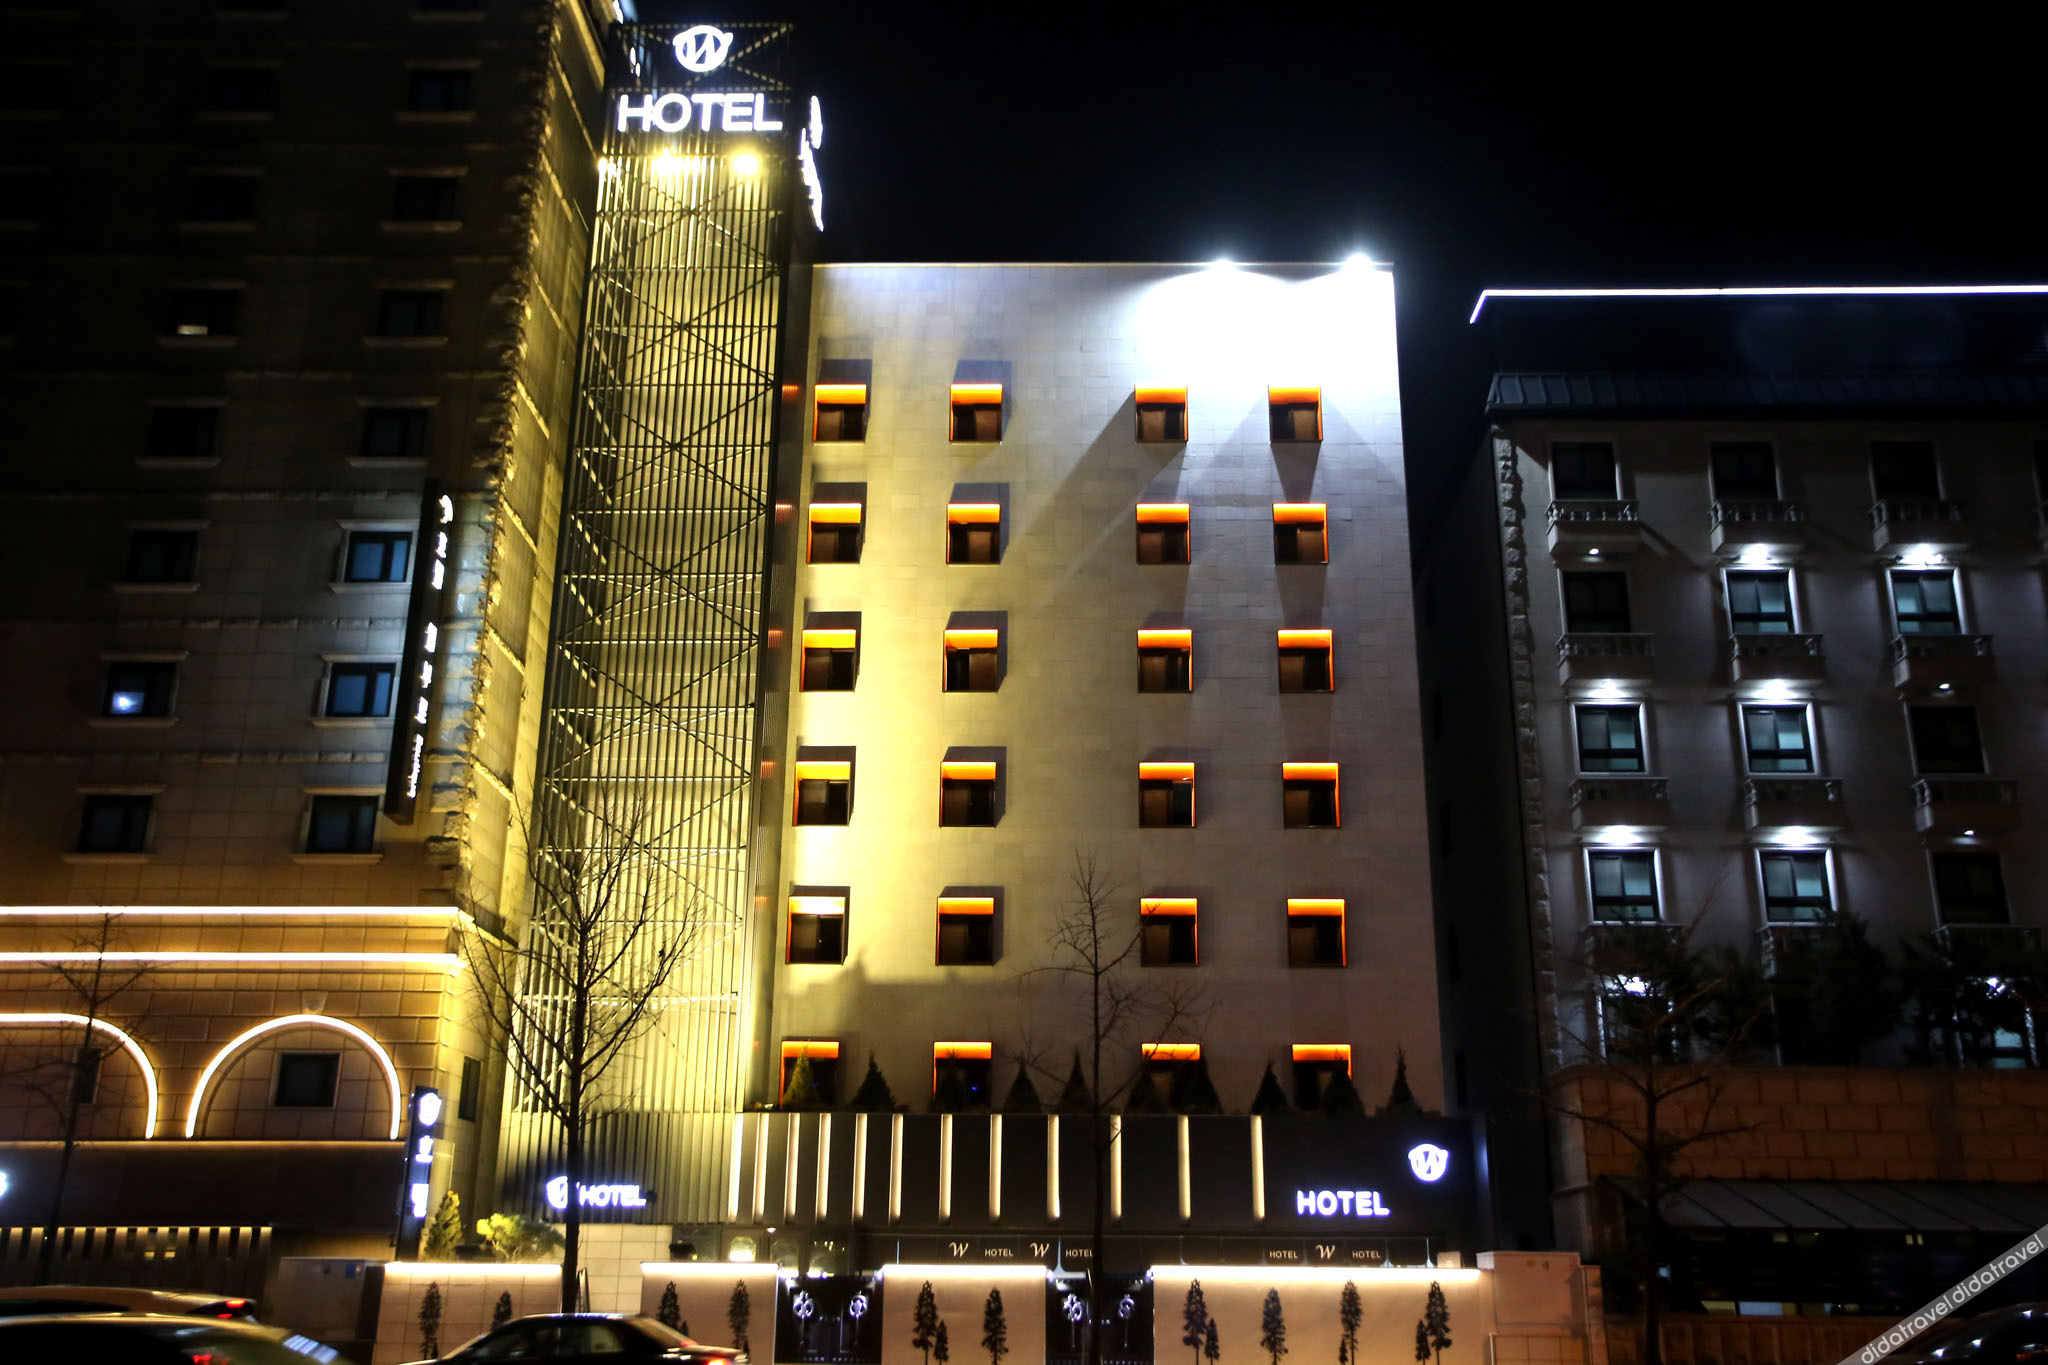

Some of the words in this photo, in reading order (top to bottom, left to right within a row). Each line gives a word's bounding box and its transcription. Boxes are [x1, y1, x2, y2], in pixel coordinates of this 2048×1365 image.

[617, 92, 784, 134] HOTEL
[579, 1183, 648, 1208] HOTEL
[1296, 1190, 1391, 1217] HOTEL
[948, 1241, 969, 1258] W
[984, 1248, 1014, 1258] HOTEL
[1029, 1242, 1050, 1258] W
[1065, 1248, 1093, 1258] HOTEL
[1269, 1250, 1299, 1260] HOTEL
[1315, 1244, 1336, 1260] W
[1351, 1250, 1382, 1260] HOTEL
